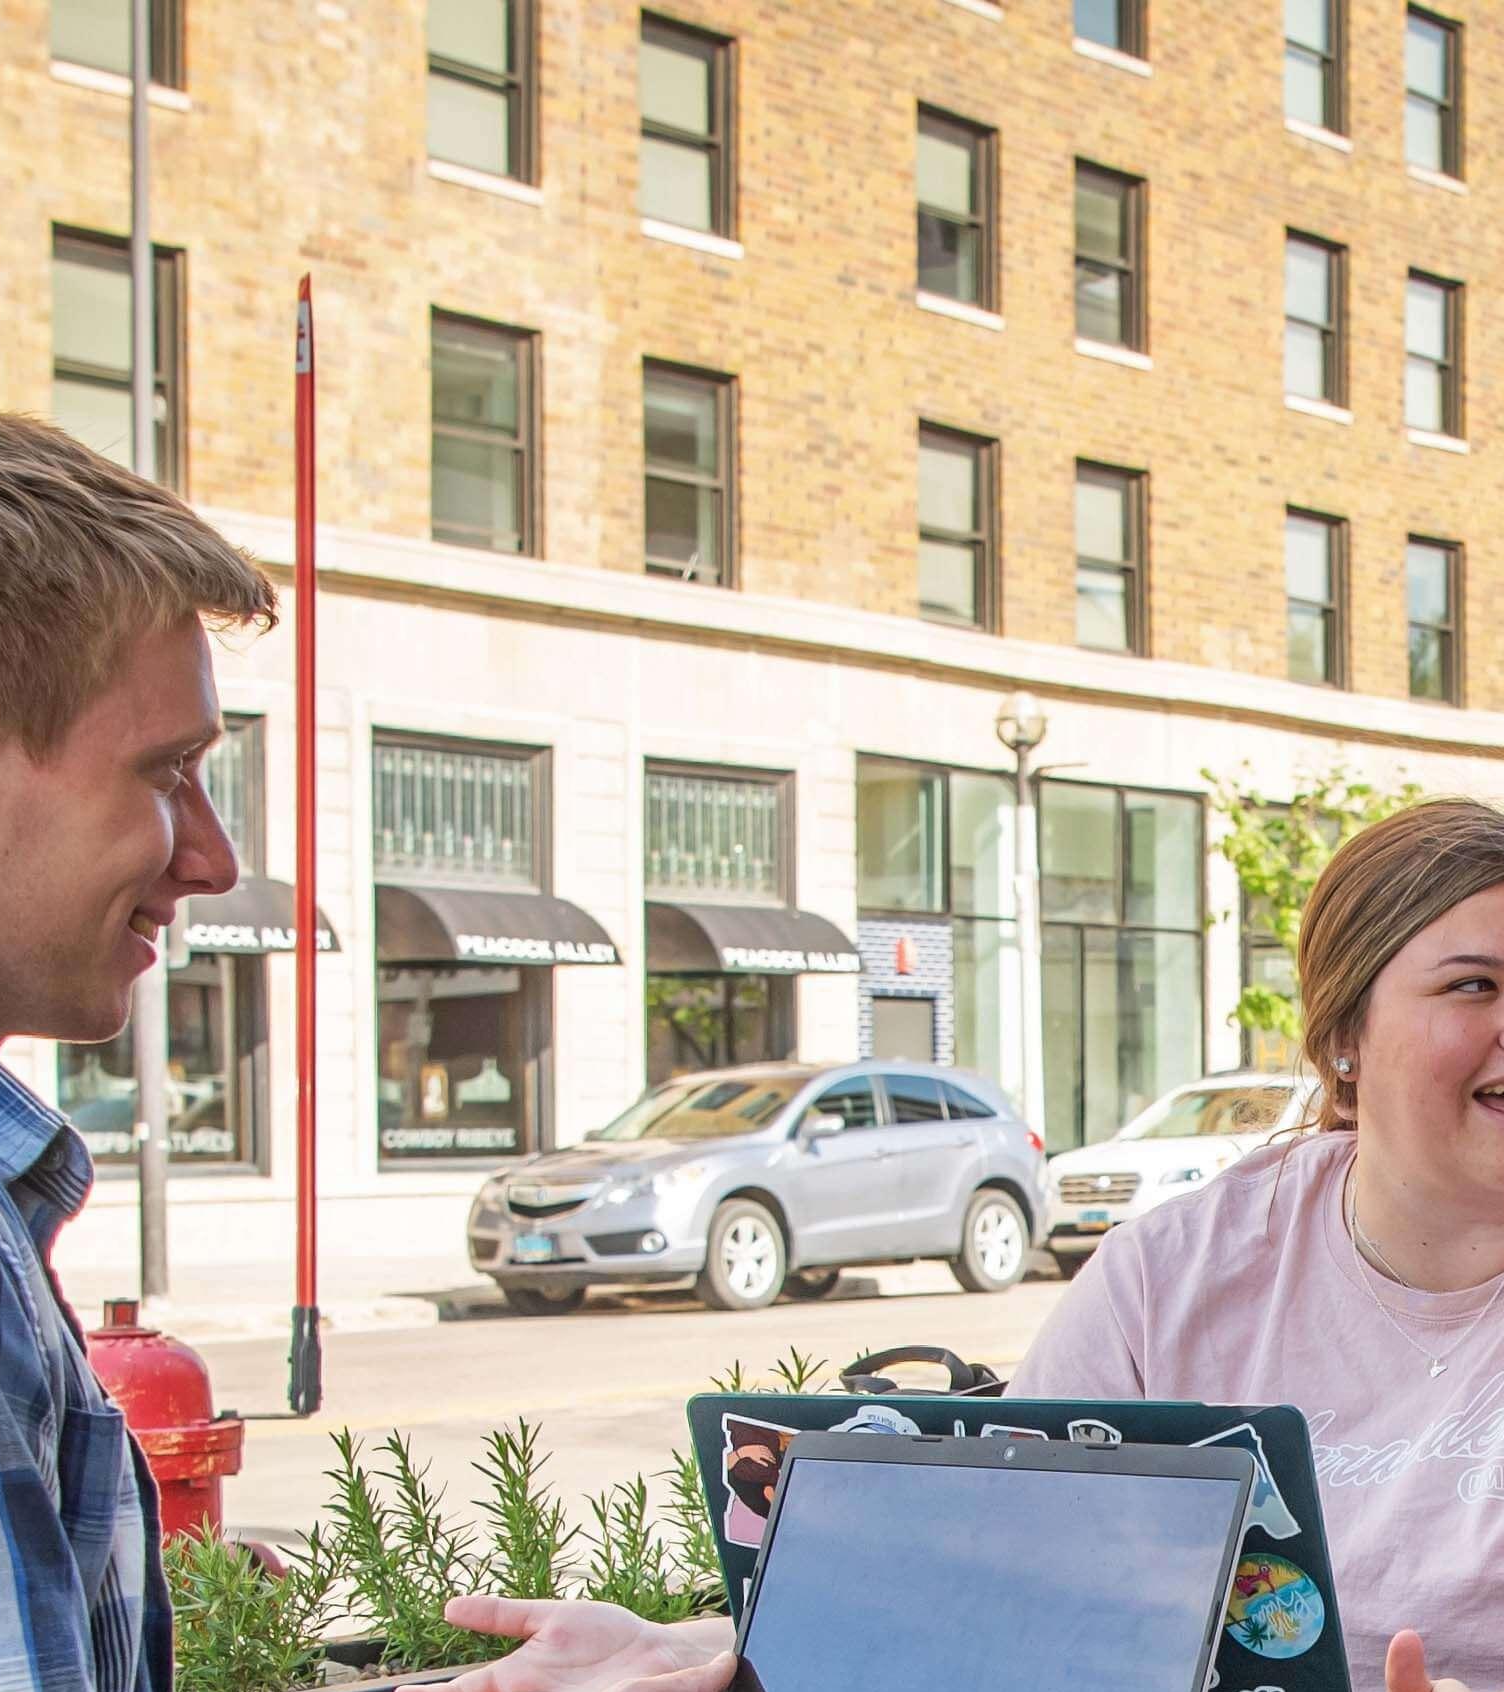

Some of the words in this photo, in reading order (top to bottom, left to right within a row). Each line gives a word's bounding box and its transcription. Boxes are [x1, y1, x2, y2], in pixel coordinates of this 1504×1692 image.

[183, 924, 260, 947] COCK
[456, 934, 555, 960] PEACOCK
[555, 941, 616, 963] ALLEY
[723, 947, 808, 970] PEACOCK
[808, 951, 861, 973] ALLEY
